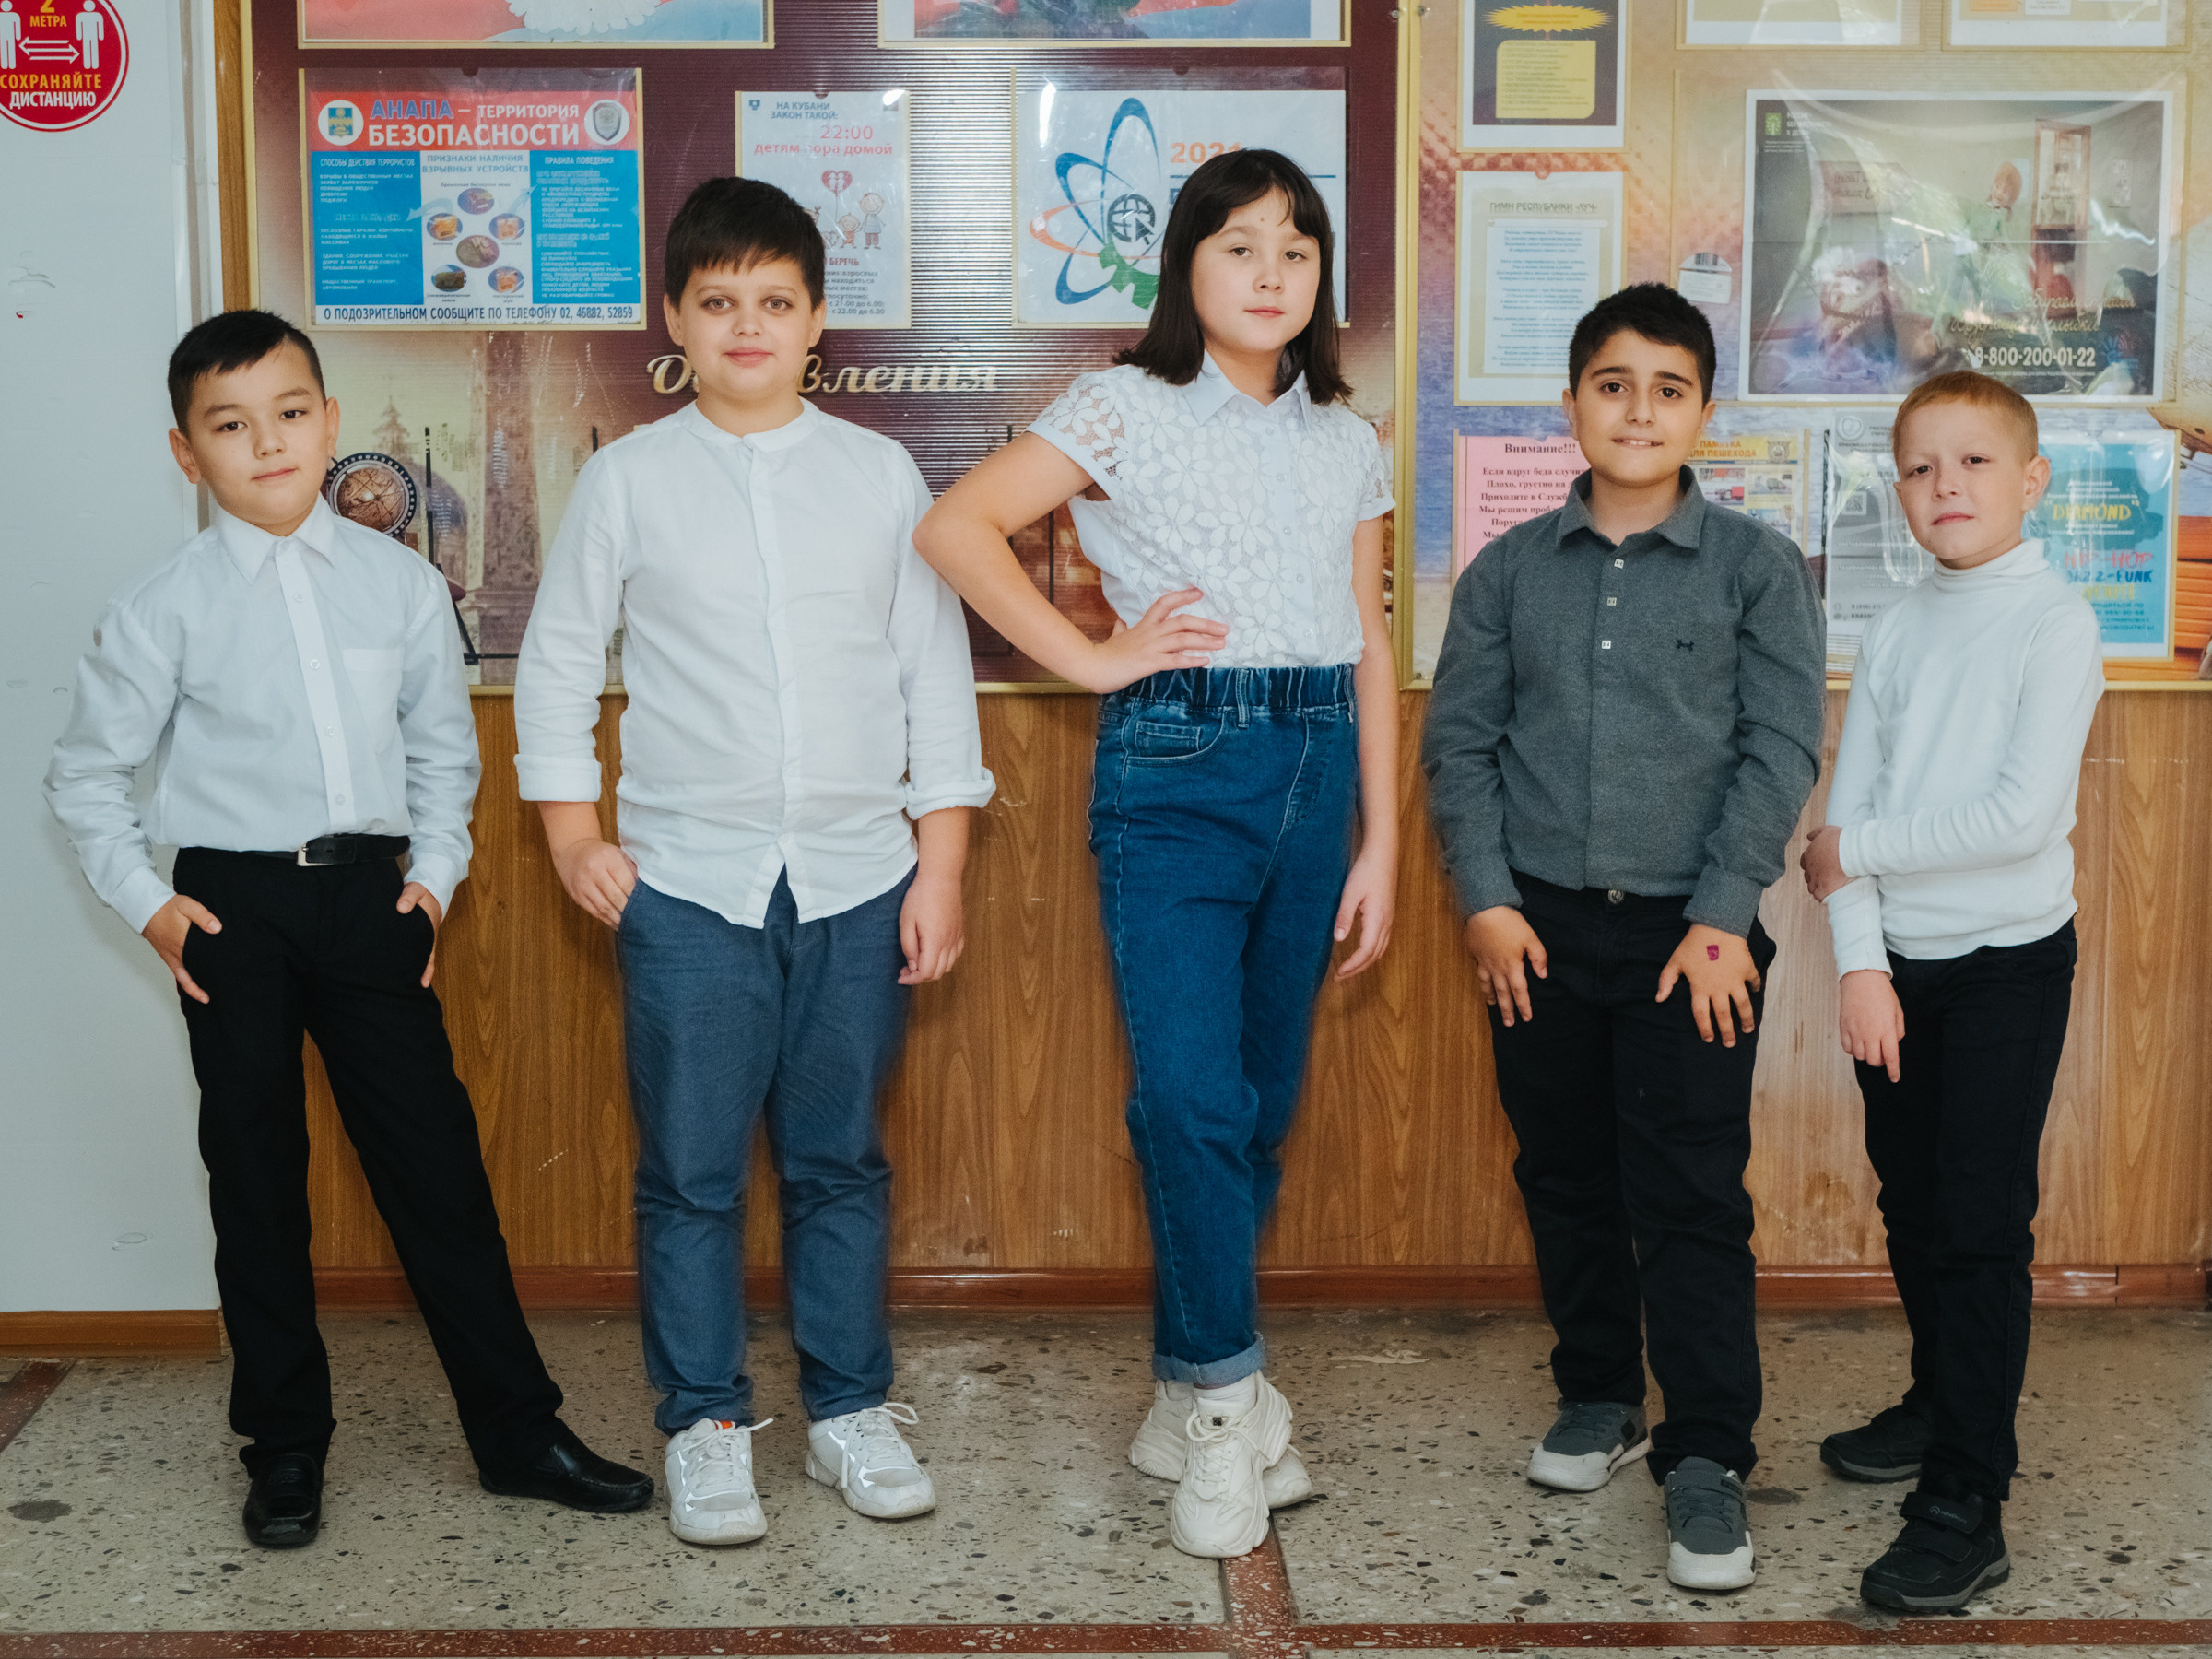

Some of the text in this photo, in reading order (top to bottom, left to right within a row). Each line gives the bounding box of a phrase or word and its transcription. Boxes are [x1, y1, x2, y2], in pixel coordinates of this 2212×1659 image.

[30, 15, 67, 27] МЕТРА
[0, 71, 102, 89] СОХРАНЯЙТЕ
[9, 91, 96, 110] ДИСТАНЦИЮ
[776, 101, 830, 111] НА КУБАНИ
[370, 100, 580, 119] АНАПА ТЕРРИТОРИЯ
[771, 109, 839, 120] ЗАКОН ТАКОЙ:
[369, 124, 580, 146] БЕЗОПАСНОСТИ
[820, 125, 874, 140] 22:00
[754, 143, 800, 156] детям
[843, 143, 893, 157] домой
[320, 157, 415, 168] СПОСОБЫ ДЕЙСТВИЯ ТЕРРОРИСТОВ
[427, 154, 524, 162] ПРИЗНАКИ НАЛИЧИЯ
[544, 156, 614, 165] ПРАВИЛА ПОВЕДЕНИЯ
[422, 163, 529, 173] ВЗРЫВНЫХ УСТРОЙСТВ
[1489, 201, 1515, 213] ГИМН
[1516, 201, 1573, 213] РЕСПУБЛИКИ
[830, 257, 860, 266] БЕРЕЧЬ
[324, 305, 634, 323] О ПОДОЗРИТЕЛЬНОМ СООБЩИТЕ ПО ТЕЛЕФОНУ 02, 46882, 52859
[646, 354, 998, 394] Овления
[1504, 442, 1577, 453] Внимание!!!
[1707, 449, 1757, 459] ПЕШЕХОДА
[1482, 466, 1585, 477] Если вдруг беда случит
[1487, 479, 1516, 489] Плохо,
[1518, 481, 1553, 490] грустно
[1480, 492, 1528, 502] Приходите
[1537, 492, 1569, 502] Служб
[1478, 505, 1495, 513] Мы
[1498, 507, 1528, 515] решим
